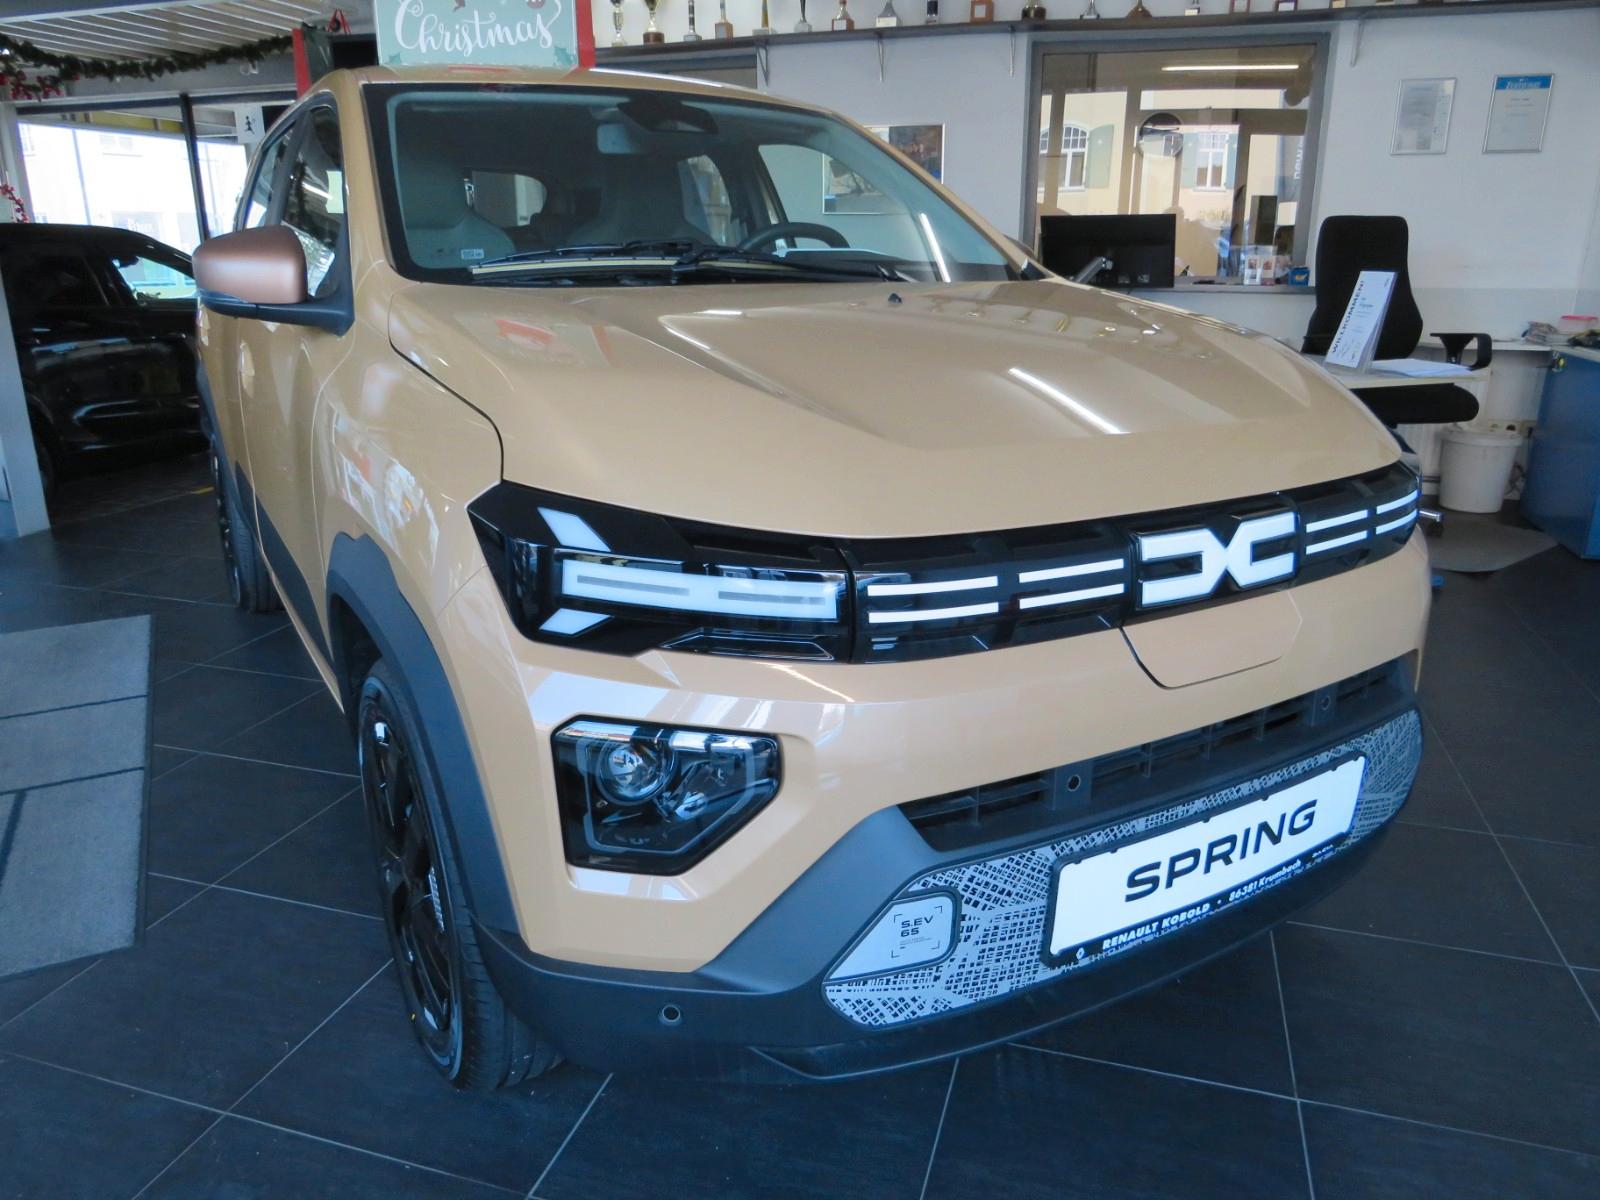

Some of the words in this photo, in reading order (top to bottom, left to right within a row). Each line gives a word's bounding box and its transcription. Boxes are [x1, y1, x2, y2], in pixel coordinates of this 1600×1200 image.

[395, 0, 561, 57] Christmas
[1124, 799, 1318, 902] SPRING
[900, 927, 920, 938] 65
[901, 915, 934, 929] S.EV
[1102, 921, 1159, 950] RENAULT
[1161, 903, 1211, 928] KOBOLD
[1228, 880, 1259, 902] 86381
[1259, 859, 1302, 888] Krumbach
